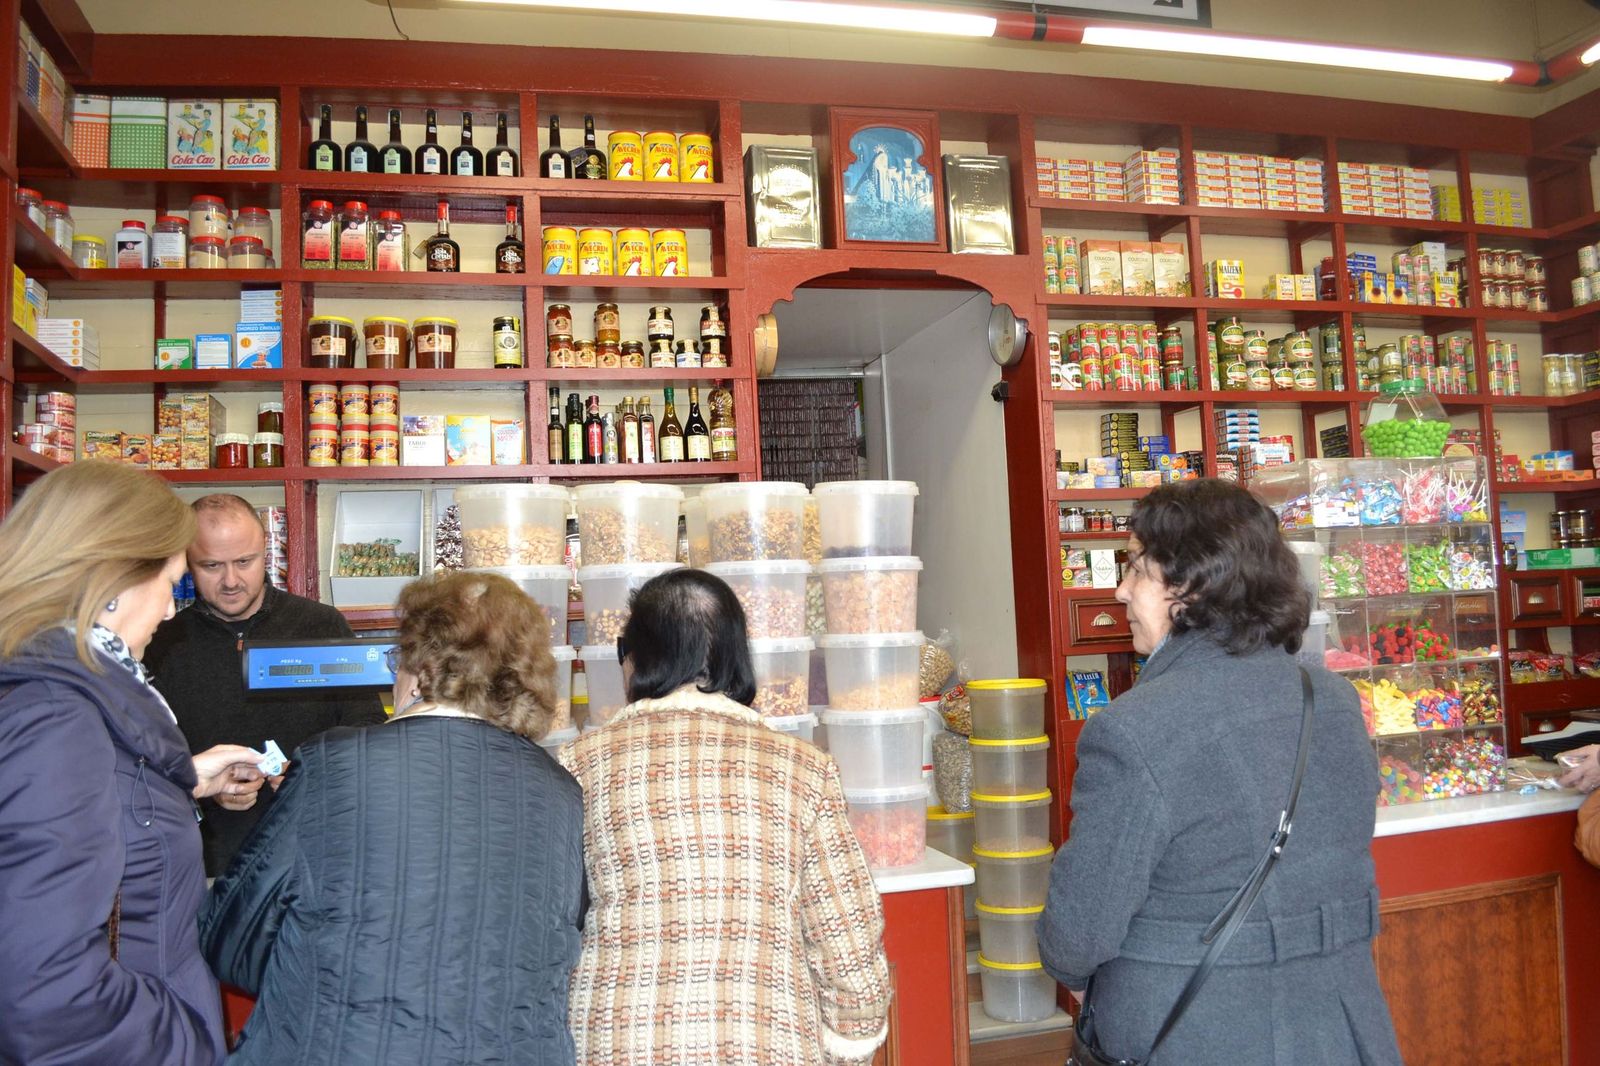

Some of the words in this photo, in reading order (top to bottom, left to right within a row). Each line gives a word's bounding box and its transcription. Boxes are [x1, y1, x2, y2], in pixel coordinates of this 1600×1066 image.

[171, 154, 194, 165] Cola
[196, 154, 216, 165] Cao
[227, 154, 249, 165] Cola
[251, 154, 271, 164] Cao
[1219, 265, 1242, 274] MAIZENA
